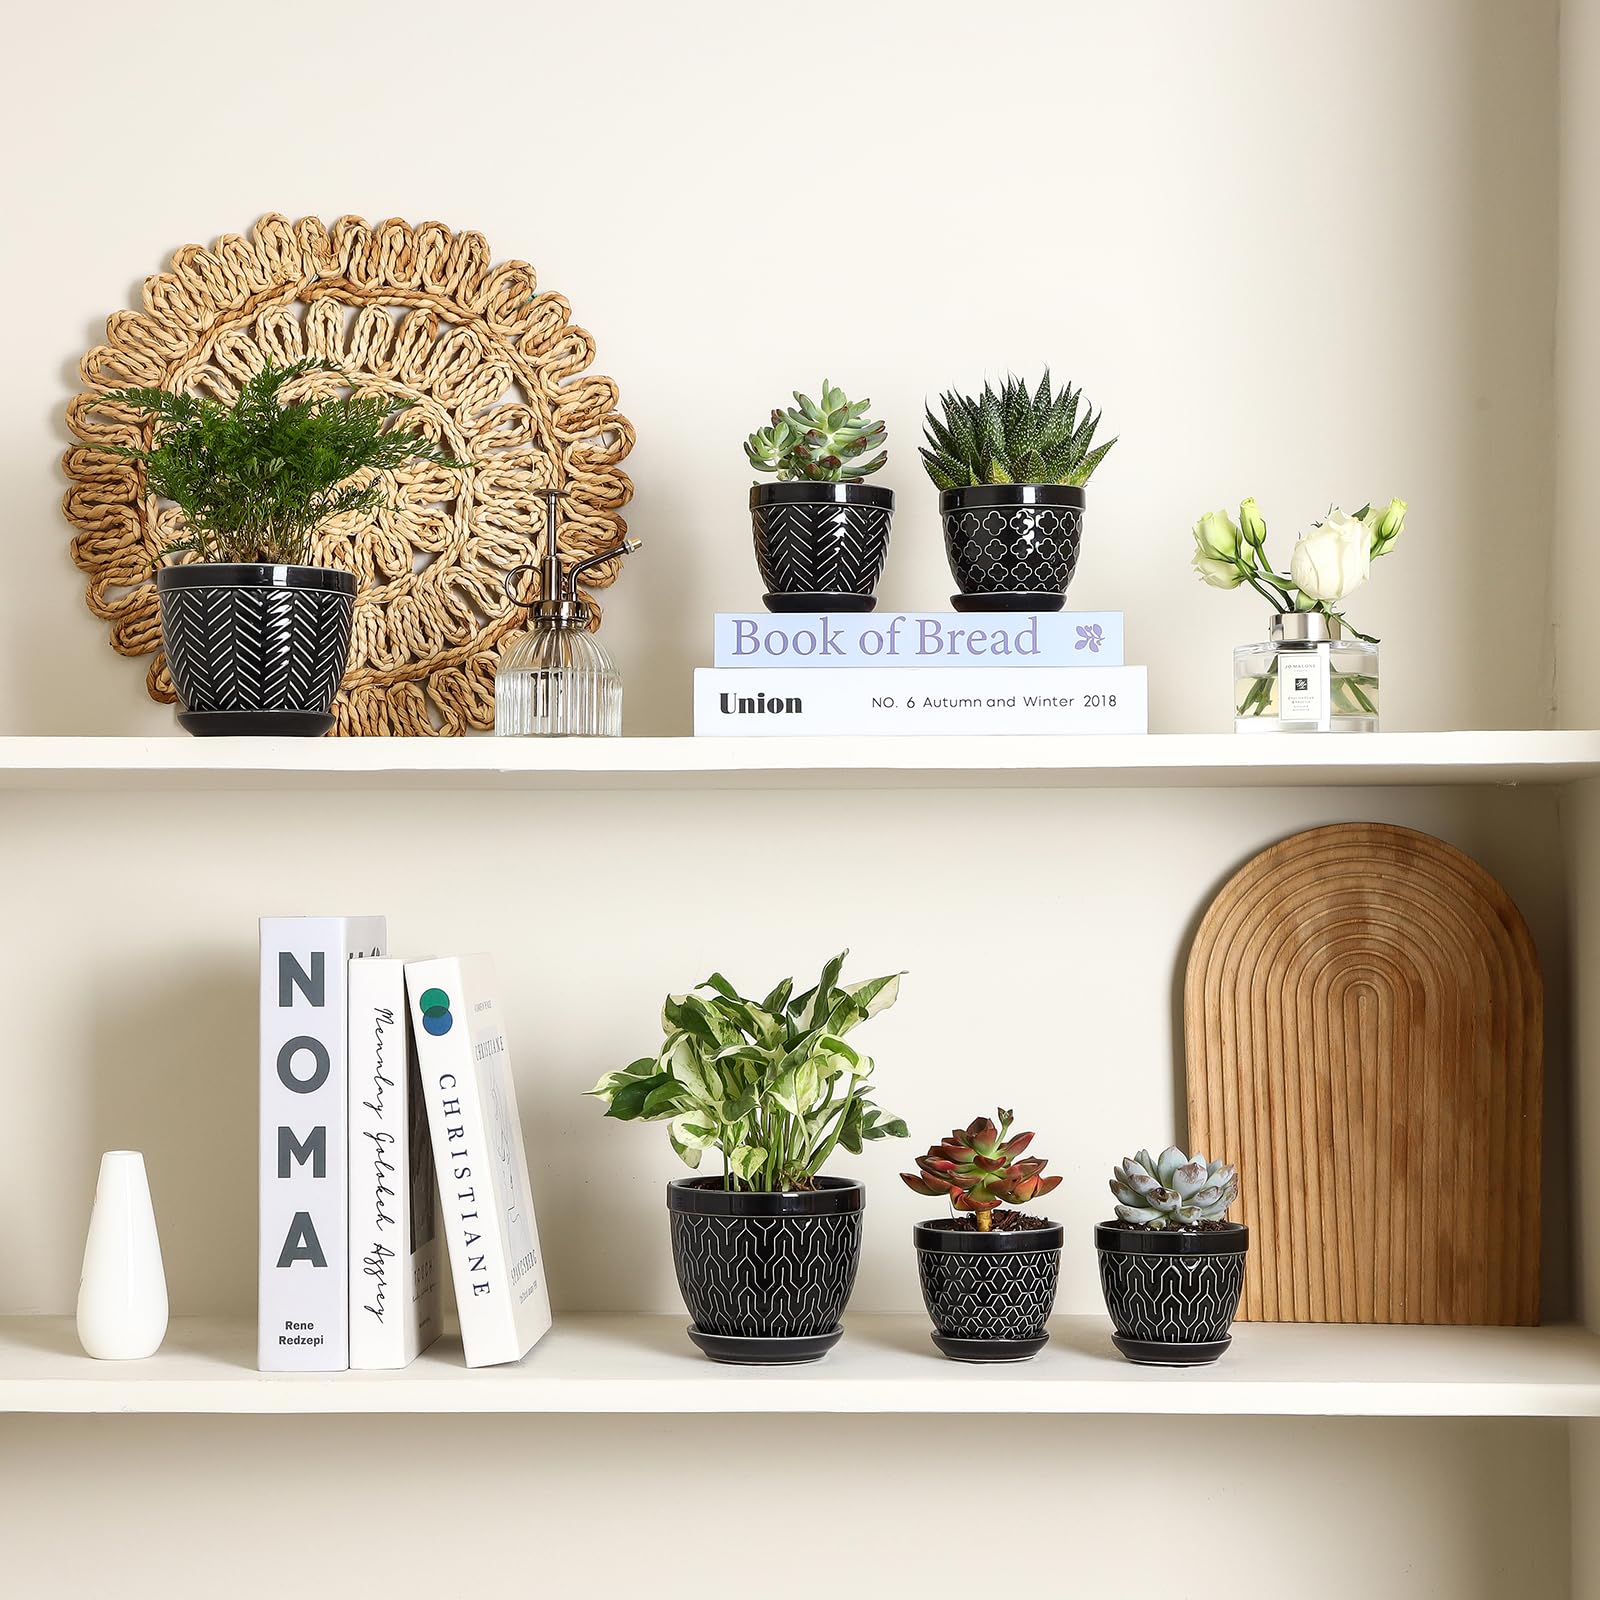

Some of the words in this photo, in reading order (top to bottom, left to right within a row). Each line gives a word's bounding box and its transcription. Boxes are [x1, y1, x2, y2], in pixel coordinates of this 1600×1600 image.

[731, 615, 847, 656] Book
[858, 615, 907, 656] of
[914, 615, 1041, 656] Bread
[719, 691, 803, 715] Union
[871, 696, 899, 709] NO.
[906, 696, 916, 709] 6
[922, 696, 982, 709] Autumn
[985, 695, 1016, 708] and
[1022, 695, 1075, 708] Winter
[1083, 694, 1117, 708] 2018
[275, 951, 331, 1269] NOMA
[437, 1073, 492, 1299] CHRISTIANE
[284, 1320, 315, 1331] Rene
[278, 1334, 324, 1348] Redzepi
